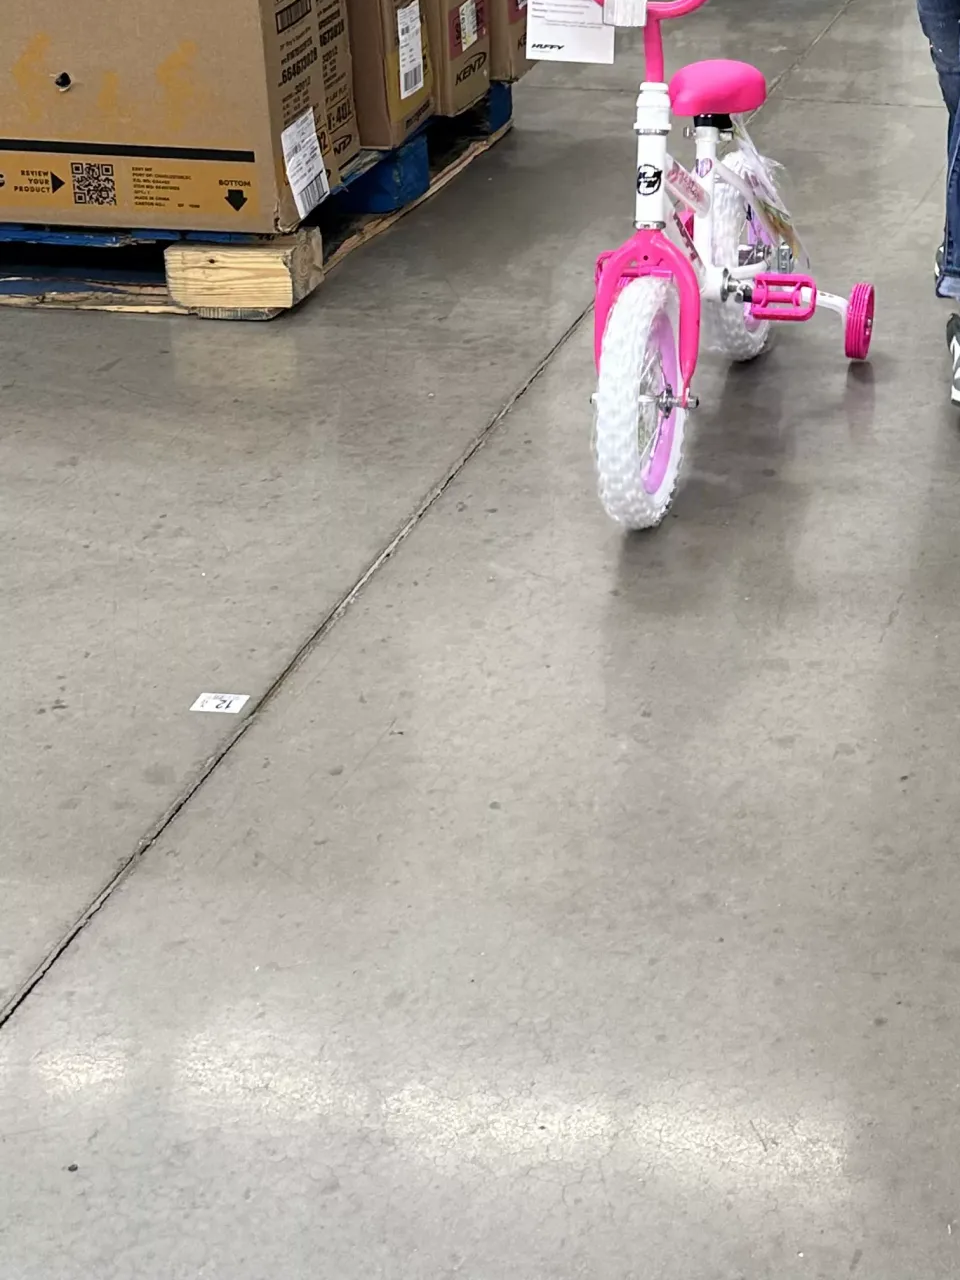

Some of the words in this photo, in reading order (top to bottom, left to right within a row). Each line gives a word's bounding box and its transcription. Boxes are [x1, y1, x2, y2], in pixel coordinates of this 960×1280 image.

[455, 53, 487, 87] KENT
[20, 169, 49, 177] REVIEW
[218, 179, 252, 188] BOTTOM
[13, 186, 51, 194] PRODUCT
